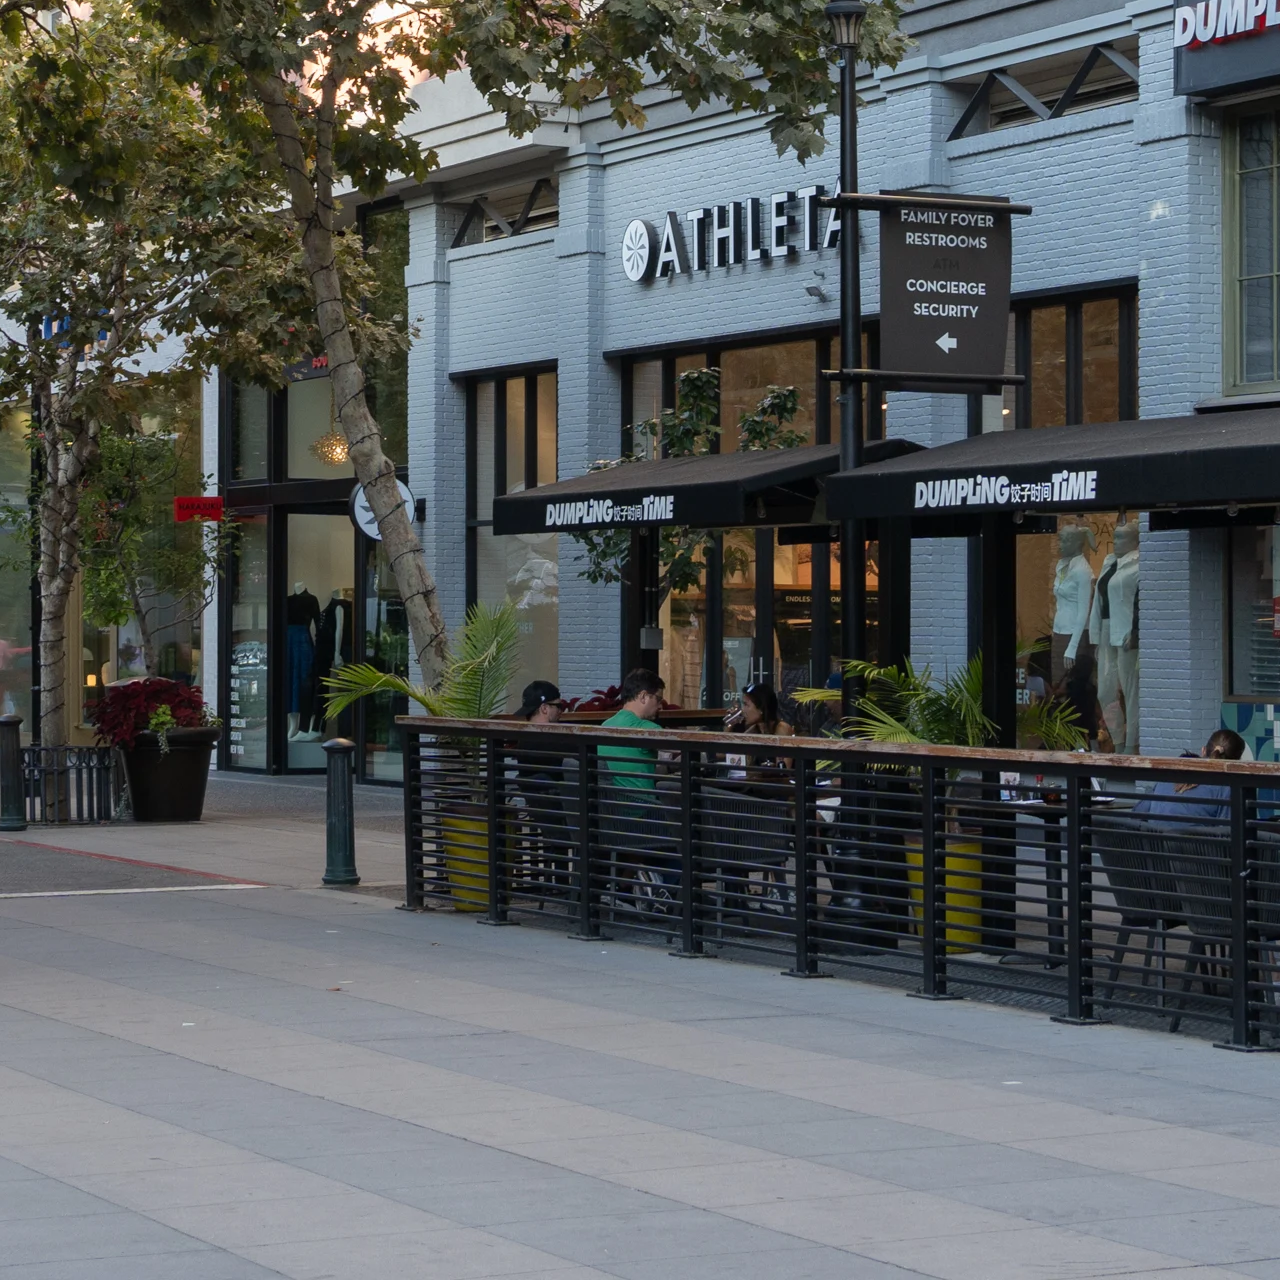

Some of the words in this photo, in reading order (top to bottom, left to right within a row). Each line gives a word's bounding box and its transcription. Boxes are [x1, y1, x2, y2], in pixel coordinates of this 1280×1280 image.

[901, 209, 947, 224] FAMILY
[951, 213, 994, 227] FOYER
[906, 232, 987, 249] RESTROOMS
[906, 279, 986, 295] CONCIERGE
[913, 303, 979, 318] SECURITY
[1010, 482, 1051, 503] 饺子时间
[613, 505, 642, 521] 饺子时间
[723, 692, 741, 701] OFF
